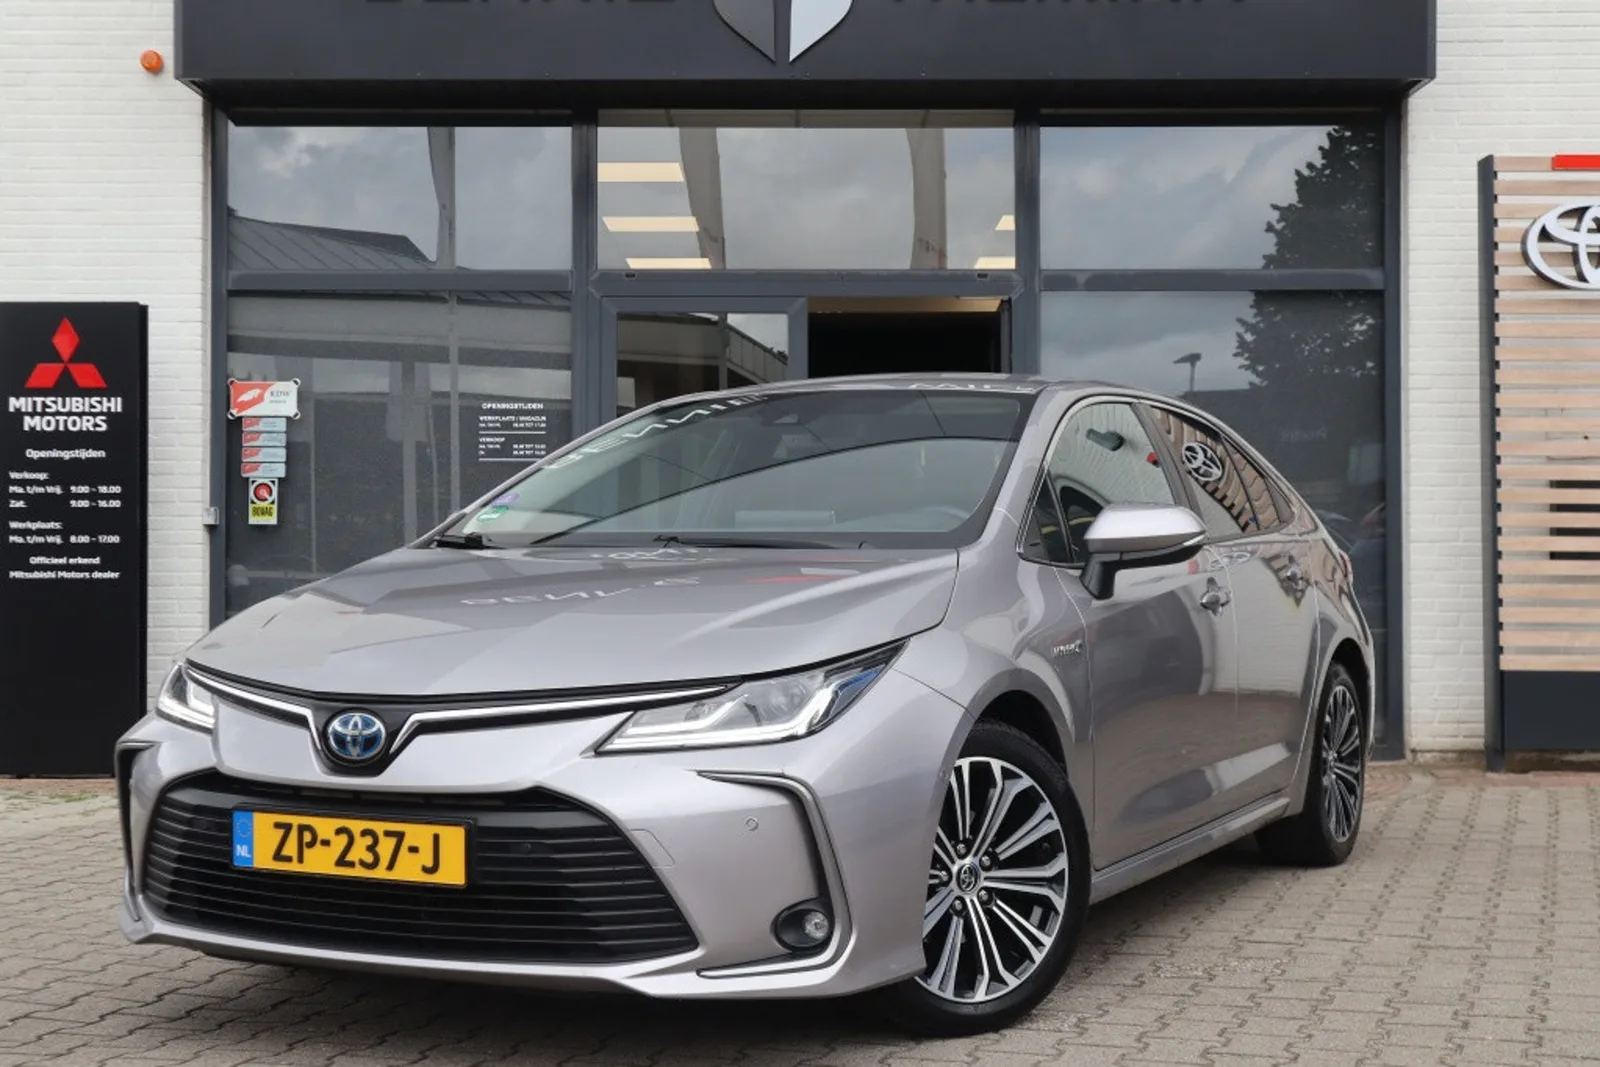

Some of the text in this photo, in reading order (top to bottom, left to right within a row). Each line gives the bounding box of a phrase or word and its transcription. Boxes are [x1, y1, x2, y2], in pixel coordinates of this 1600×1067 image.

[8, 397, 122, 413] MITSUBISHI
[23, 415, 108, 432] MOTORS
[25, 449, 106, 460] Openingstijden
[9, 471, 49, 481] Verkoop:
[9, 521, 63, 531] Werkplaats:
[29, 556, 101, 565] Officieel erkend
[9, 570, 120, 579] Mitsubishi Motors dealer
[235, 844, 251, 858] NL
[272, 821, 440, 875] ZP-237-J
